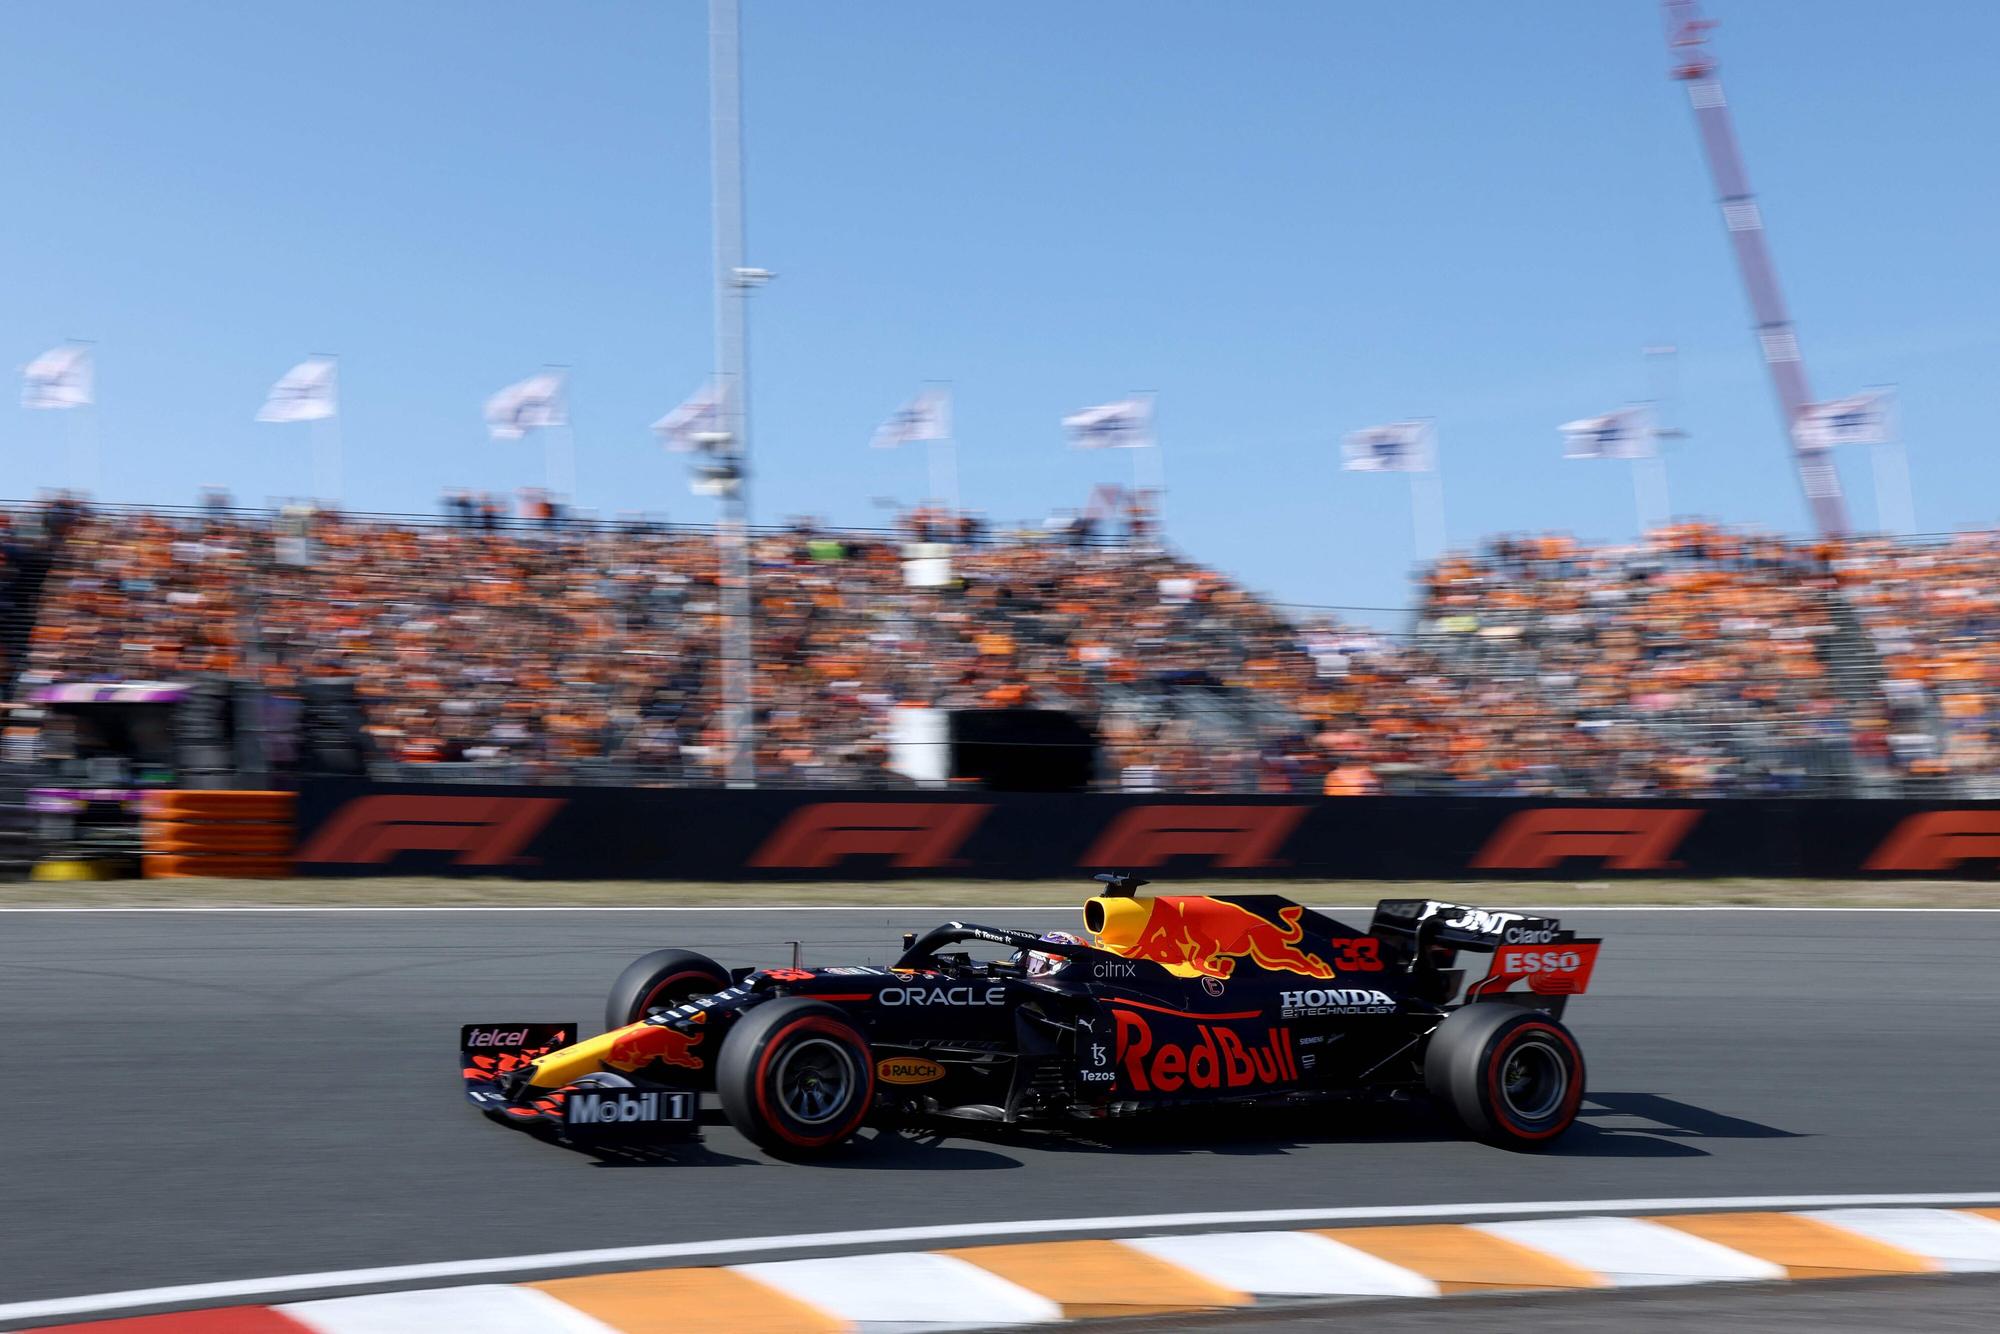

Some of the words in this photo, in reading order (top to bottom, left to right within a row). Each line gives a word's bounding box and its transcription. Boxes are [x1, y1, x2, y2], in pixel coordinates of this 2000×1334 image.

[982, 931, 1003, 942] Tezos
[1505, 926, 1552, 943] Claro
[1331, 937, 1384, 971] 33
[1504, 952, 1581, 973] ESSO
[1093, 960, 1136, 978] citrix
[878, 987, 1006, 1006] ORACLE
[1280, 989, 1396, 1009] HONDA
[467, 1028, 529, 1047] telcel
[892, 1066, 936, 1076] RAUCH
[1080, 1070, 1115, 1081] Tezos
[569, 1092, 659, 1123] Mobil
[669, 1095, 683, 1118] 1
